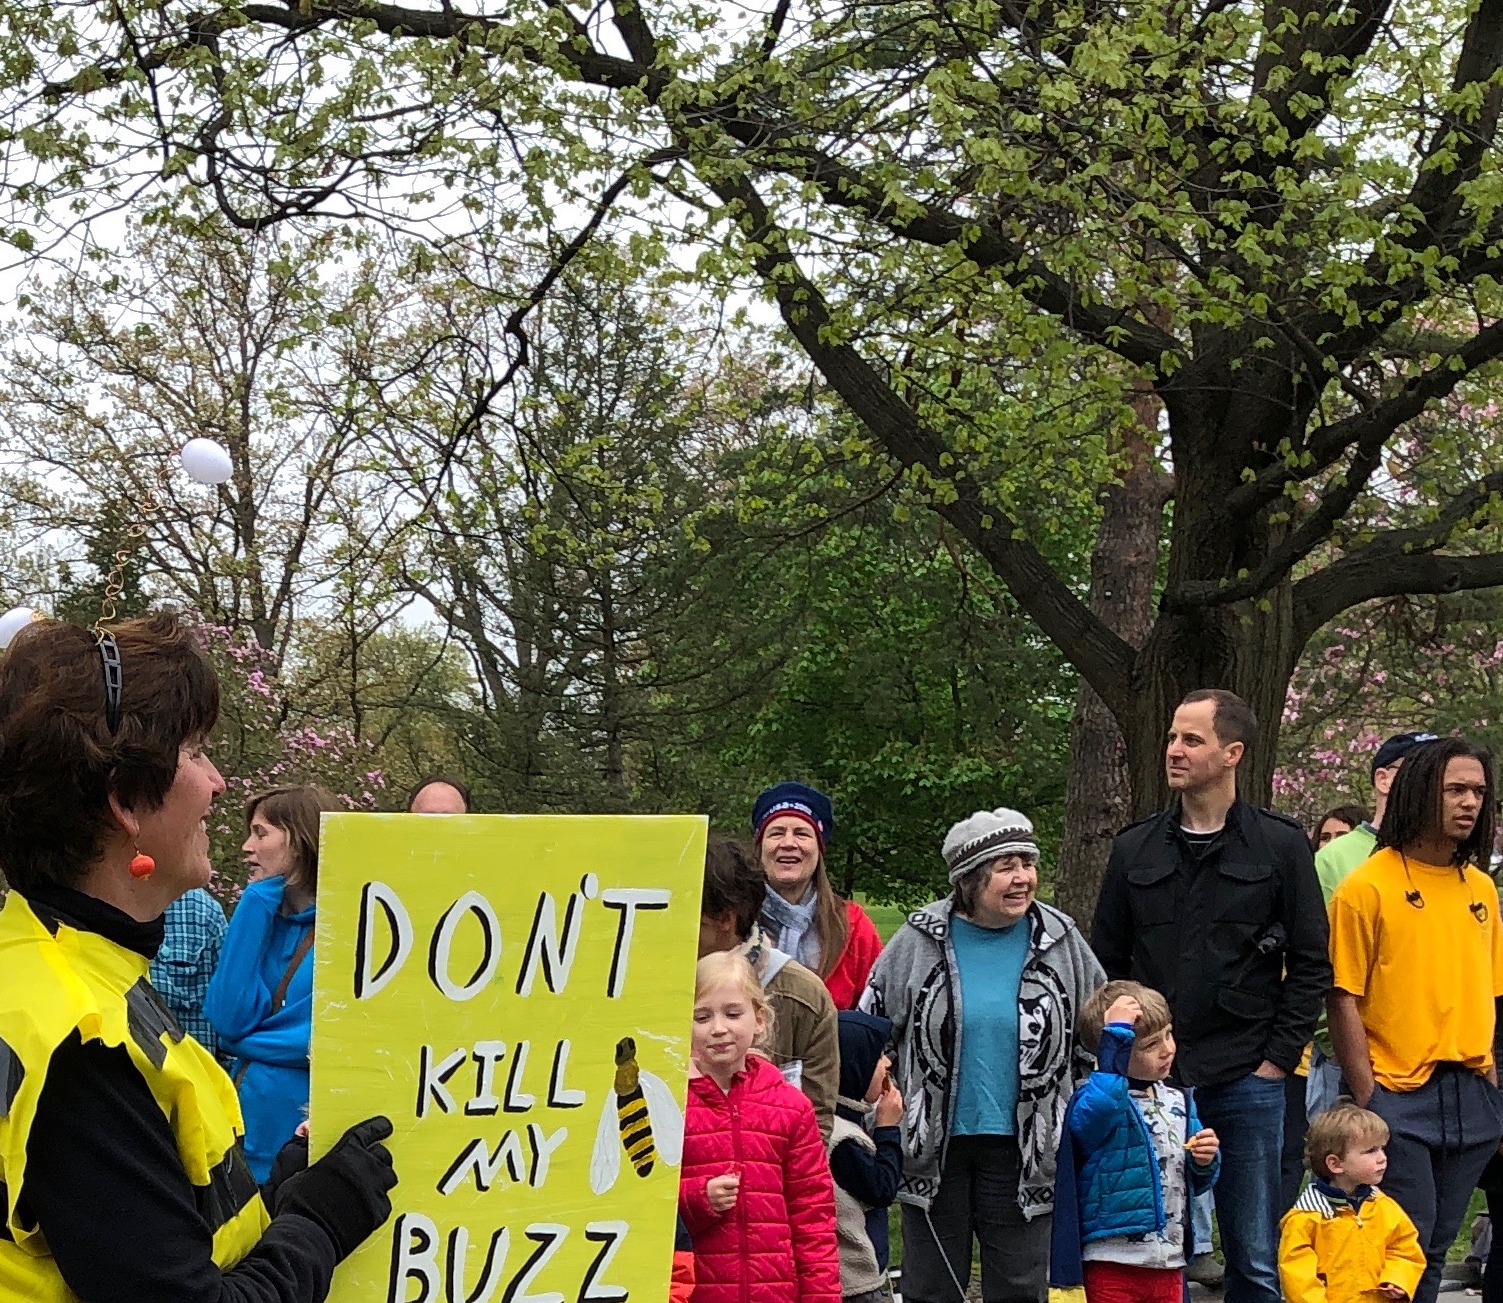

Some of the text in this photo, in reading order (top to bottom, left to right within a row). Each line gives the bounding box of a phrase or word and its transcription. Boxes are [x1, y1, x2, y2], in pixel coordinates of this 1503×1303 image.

[354, 872, 672, 1001] DON'T
[416, 1039, 587, 1118] KILL
[436, 1123, 568, 1195] MY
